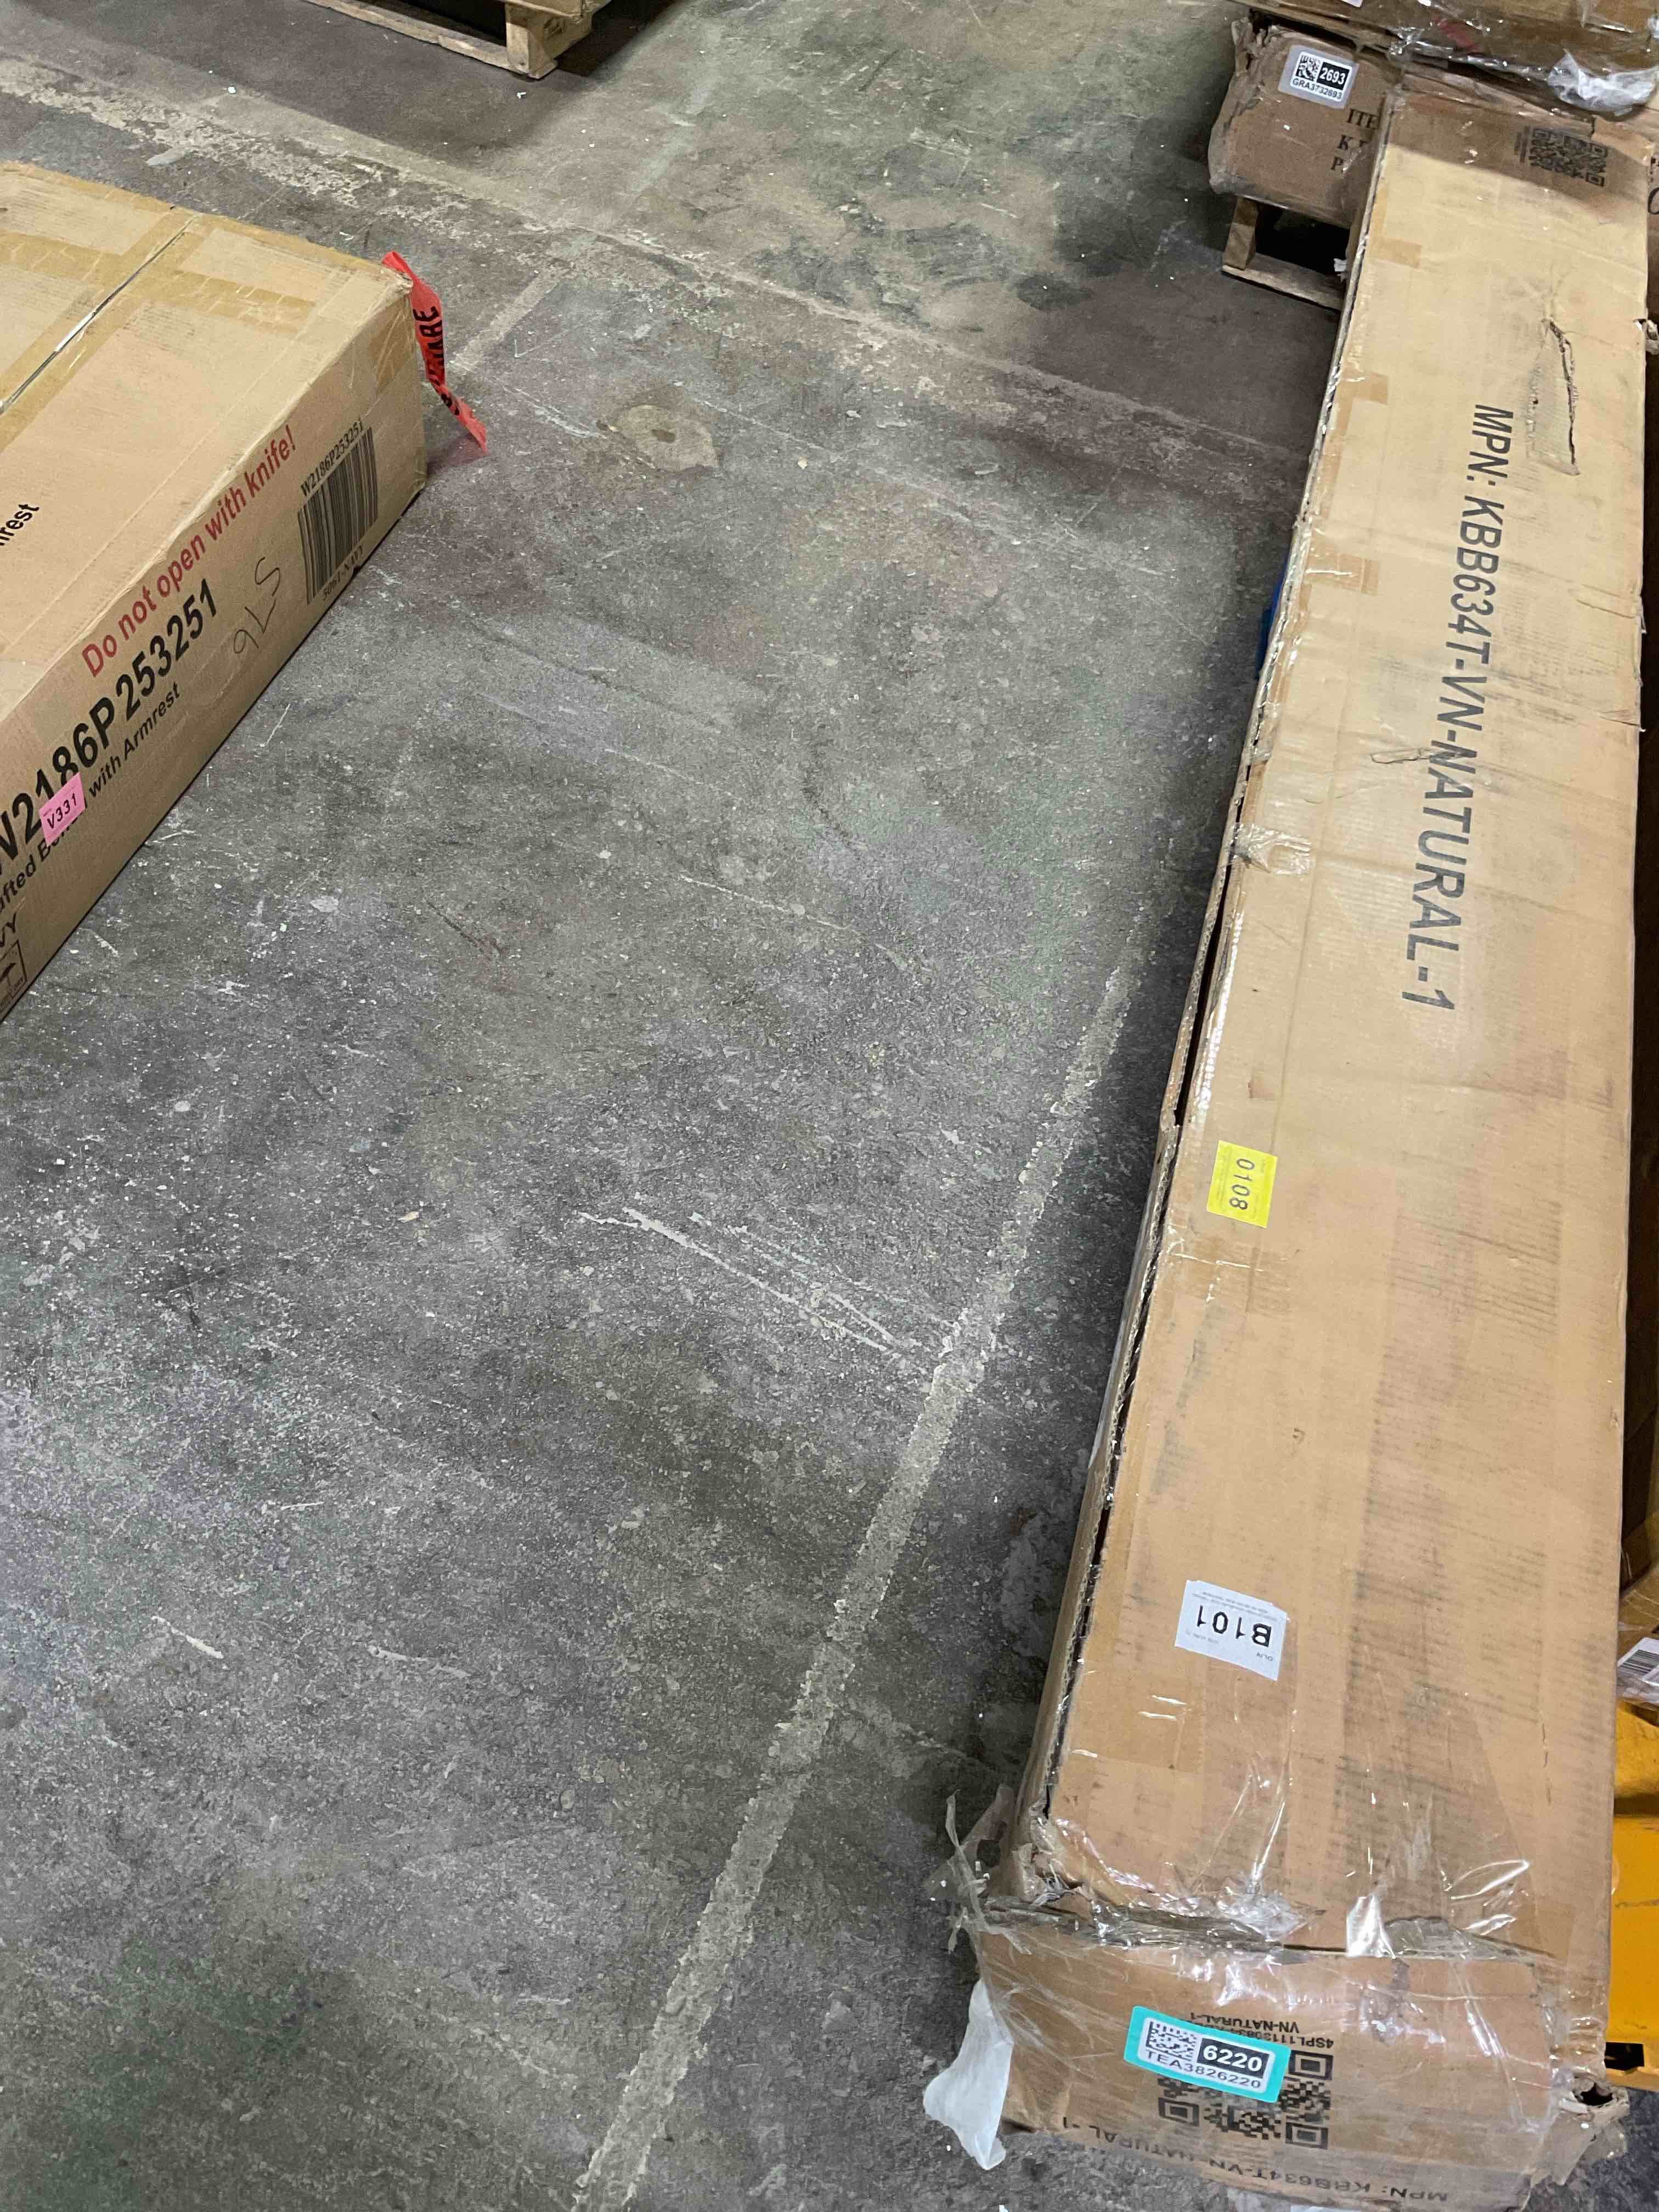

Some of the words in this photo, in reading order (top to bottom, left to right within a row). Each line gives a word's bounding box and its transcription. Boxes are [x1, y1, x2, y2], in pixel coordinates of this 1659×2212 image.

[1293, 77, 1343, 99] GRA3732693
[1319, 67, 1346, 85] 2693
[1465, 404, 1514, 487] MPN:
[82, 634, 118, 678] Do
[118, 585, 157, 640] not
[157, 534, 206, 598] open
[205, 486, 247, 540] with
[245, 425, 296, 498] knife!
[89, 755, 122, 798] with
[124, 681, 180, 760] Armrest
[1402, 495, 1504, 1011] KBB634T-VN-NATURAL-1
[46, 792, 77, 829] V331
[1229, 1158, 1255, 1210] 0108
[1197, 1605, 1272, 1647] B101
[1190, 2012, 1300, 2034] VN-NATURAL-1
[1146, 2049, 1261, 2089] TEA3826220
[1203, 2045, 1262, 2072] 6220
[1382, 2186, 1448, 2203] MPN:
